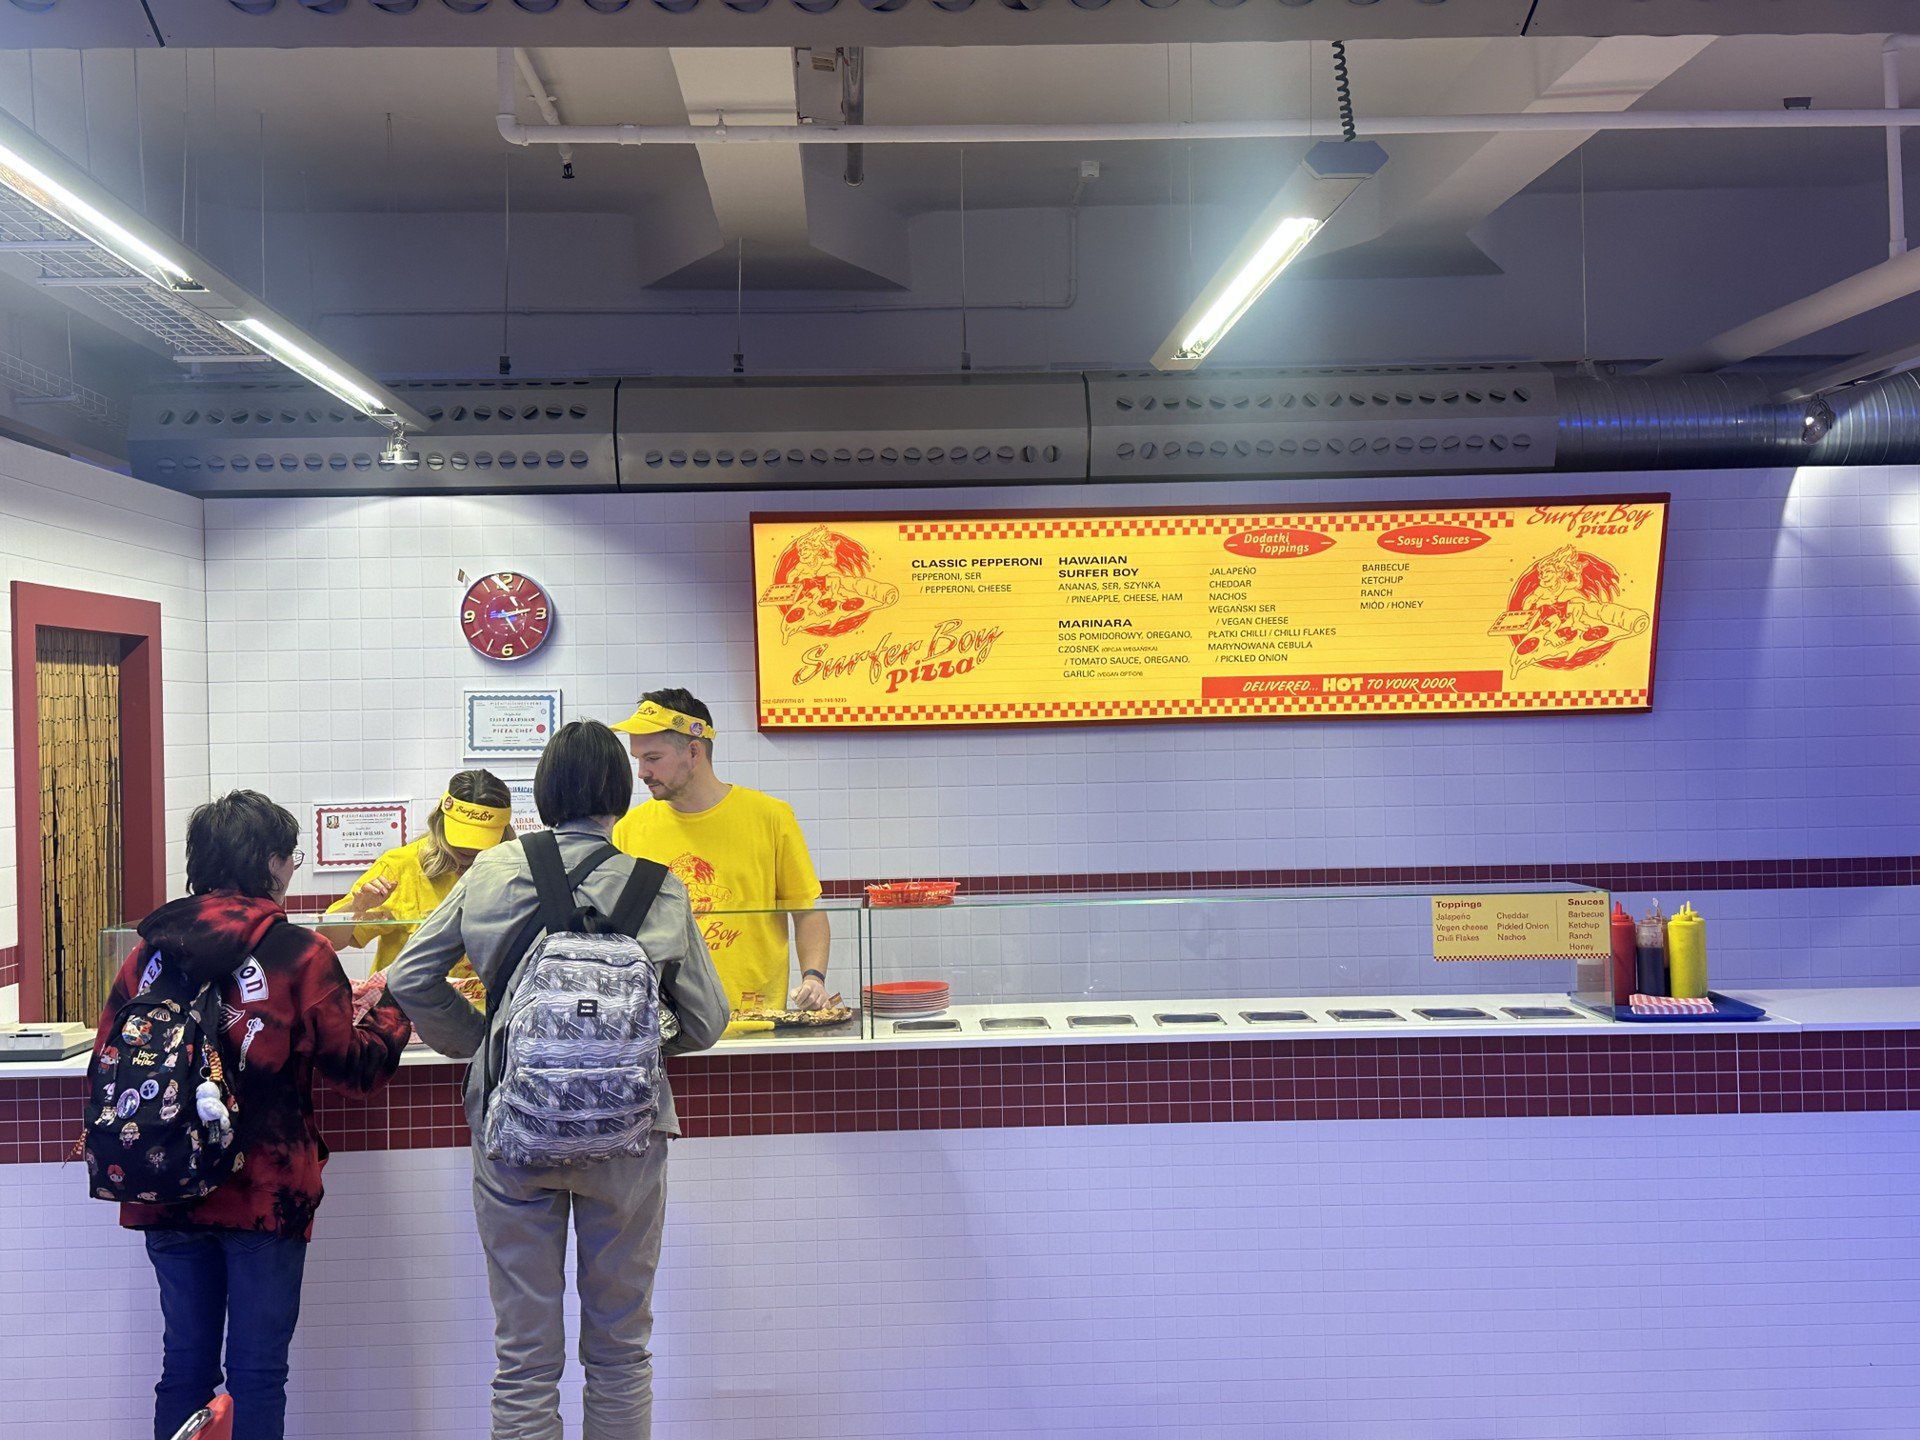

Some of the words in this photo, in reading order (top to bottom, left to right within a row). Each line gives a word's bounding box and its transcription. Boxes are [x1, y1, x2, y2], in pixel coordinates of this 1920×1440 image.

[1526, 504, 1606, 532] Surfer
[1604, 503, 1654, 531] Boy
[1575, 521, 1629, 538] pizza
[1243, 532, 1290, 544] Dodatki
[1396, 535, 1424, 548] Sosy
[1431, 534, 1470, 545] Sauces
[1259, 543, 1310, 556] Toppings
[911, 559, 968, 569] CLASSIC
[971, 557, 1043, 567] PEPPERONI
[1058, 555, 1128, 565] HAWAIIAN
[1209, 565, 1257, 575] JALAPEÑO
[1362, 563, 1410, 572] BARBECUE
[911, 572, 963, 581] PEPPERONI,
[965, 571, 982, 580] SER
[1058, 569, 1109, 578] SURFER
[1112, 568, 1139, 577] BOY
[1209, 580, 1252, 589] CHEDDAR
[1361, 575, 1403, 585] KETCHUP
[925, 585, 975, 594] PEPPERONI,
[978, 584, 1012, 593] CHEESE
[1058, 583, 1099, 591] ANANAS,
[1123, 581, 1161, 589] SZYNKA
[1208, 592, 1247, 601] NACHOS
[1360, 588, 1393, 597] RANCH
[1071, 595, 1121, 603] PINEAPPLE,
[1123, 594, 1159, 602] CHEESE,
[1161, 593, 1183, 602] HAM
[1208, 603, 1257, 613] WEGAŃSKI
[1258, 604, 1276, 612] SER
[1360, 600, 1385, 610] MIÓD
[1391, 600, 1424, 609] HONEY
[463, 610, 476, 624] 9
[534, 607, 547, 620] 3
[1058, 619, 1133, 629] MARINARA
[1221, 617, 1253, 626] VEGAN
[1254, 616, 1289, 625] CHEESE
[1058, 632, 1077, 641] SOS
[1207, 629, 1238, 639] PŁATKI
[1240, 629, 1267, 638] CHILLI
[1273, 628, 1301, 637] CHILLI
[1303, 627, 1337, 636] FLAKES
[501, 643, 514, 656] 6
[1058, 645, 1099, 654] CZOSNEK
[1207, 641, 1276, 651] MARYNOWANA
[1277, 641, 1313, 649] CEBULA
[791, 632, 924, 686] Surfer
[921, 618, 1004, 665] Boy
[1070, 657, 1108, 666] TOMATO
[1109, 656, 1141, 665] SAUCE,
[1220, 654, 1256, 663] PICKLED
[1258, 653, 1288, 662] ONION
[885, 656, 974, 694] pizza
[1063, 669, 1095, 678] GARLIC
[1322, 677, 1364, 693] HOT
[1366, 679, 1383, 690] TO
[1385, 678, 1421, 694] YOUR
[1420, 677, 1459, 693] DOOR
[1436, 900, 1482, 910] Toppings
[1568, 898, 1605, 907] Sauces
[1496, 911, 1529, 920] Cheddar
[1568, 910, 1605, 918] Barbecue
[1461, 923, 1489, 931] cheese
[1497, 922, 1524, 931] Pickled
[1525, 922, 1550, 931] Onion
[1568, 921, 1600, 931] Ketchup
[703, 921, 743, 948] Boy
[1455, 934, 1480, 942] Flakes
[1497, 933, 1527, 942] Nachos
[1569, 932, 1593, 940] Ranch
[1569, 943, 1595, 952] Honey
